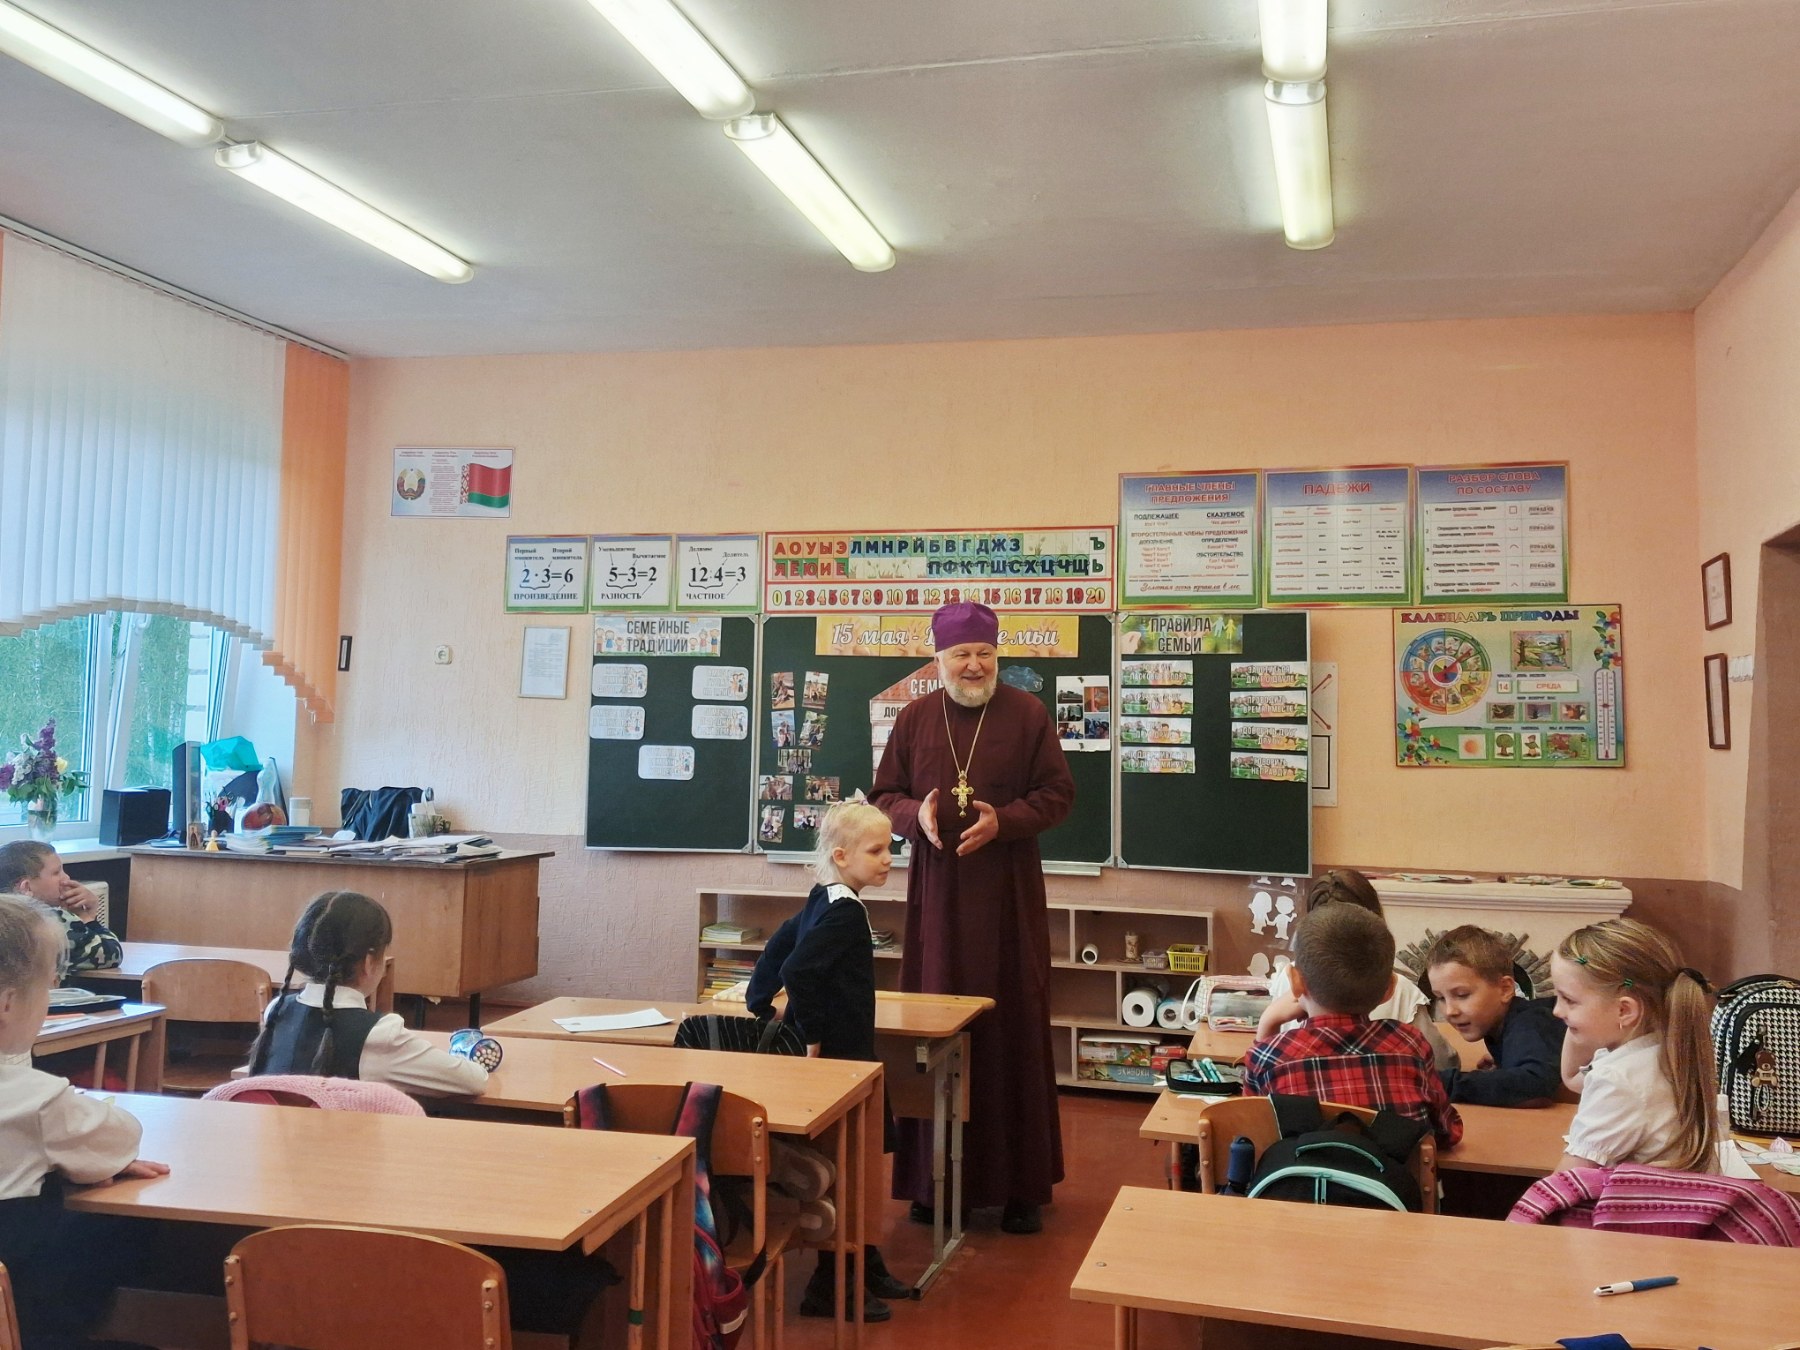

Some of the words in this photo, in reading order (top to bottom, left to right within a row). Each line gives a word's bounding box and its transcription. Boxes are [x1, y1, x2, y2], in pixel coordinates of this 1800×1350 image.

[1449, 473, 1496, 483] РАЗБОР
[1498, 471, 1540, 481] СЛОВА
[1145, 484, 1196, 493] ГЛАВНЫЕ
[1304, 483, 1371, 496] ПАДЕЖИ
[1457, 486, 1475, 495] ПО
[1477, 484, 1532, 494] СОСТАВУ
[1152, 494, 1230, 504] ПРЕДЛОЖЕНИЯ
[686, 592, 725, 600] ЧАСТНОЕ
[772, 590, 782, 606] 0
[784, 590, 792, 606] 1
[795, 590, 804, 606] 2
[806, 590, 815, 606] 3
[817, 590, 826, 606] 4
[828, 590, 838, 606] 5
[840, 590, 850, 606] 6
[852, 590, 860, 606] 7
[862, 590, 872, 606] 8
[874, 590, 883, 605] 9
[886, 590, 904, 605] 10
[906, 589, 919, 605] 11
[924, 589, 940, 605] 12
[944, 588, 960, 604] 13
[964, 588, 980, 604] 14
[984, 588, 1001, 604] 15
[1004, 588, 1022, 604] 16
[1025, 588, 1042, 604] 17
[1045, 588, 1062, 604] 18
[1066, 588, 1084, 604] 19
[1086, 588, 1106, 604] 20
[1400, 611, 1497, 624] КАЛЕНДАРЬ
[1500, 609, 1579, 621] ПРИРОДЫ
[627, 618, 690, 635] СЕМЕЙНЫЕ
[1150, 617, 1212, 632] ПРАВИЛА
[832, 623, 855, 646] 15
[858, 629, 909, 646] мая
[996, 630, 1060, 647] емьи
[626, 638, 688, 653] ТРАДИЦИИ
[1158, 637, 1202, 652] СЕМЬИ
[1536, 682, 1562, 690] СРЕДА
